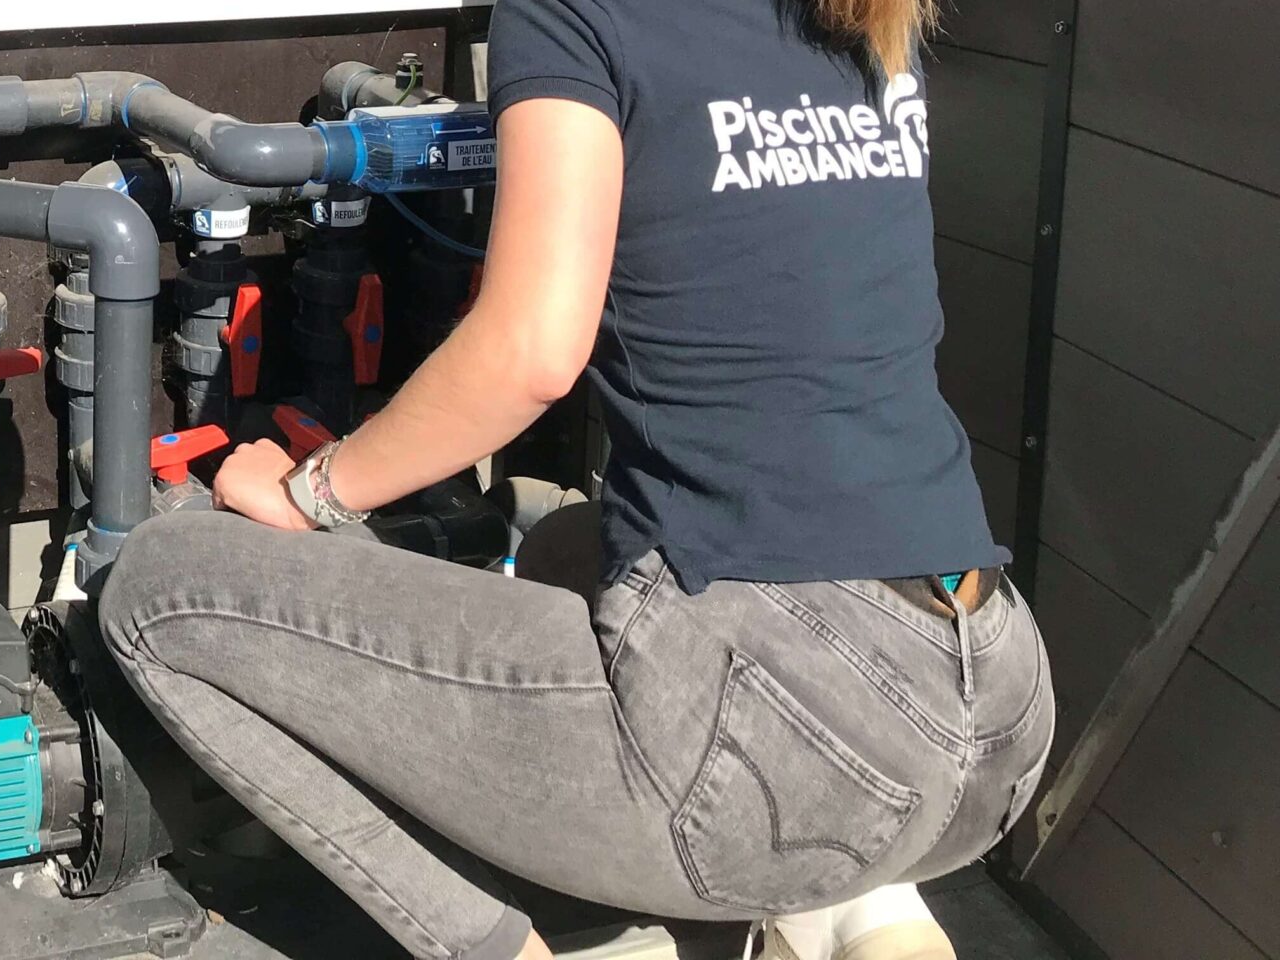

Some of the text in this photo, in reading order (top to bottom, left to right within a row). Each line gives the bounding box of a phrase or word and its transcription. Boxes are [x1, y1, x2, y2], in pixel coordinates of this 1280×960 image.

[707, 94, 882, 152] Piscine
[462, 155, 492, 167] DE L'EAU
